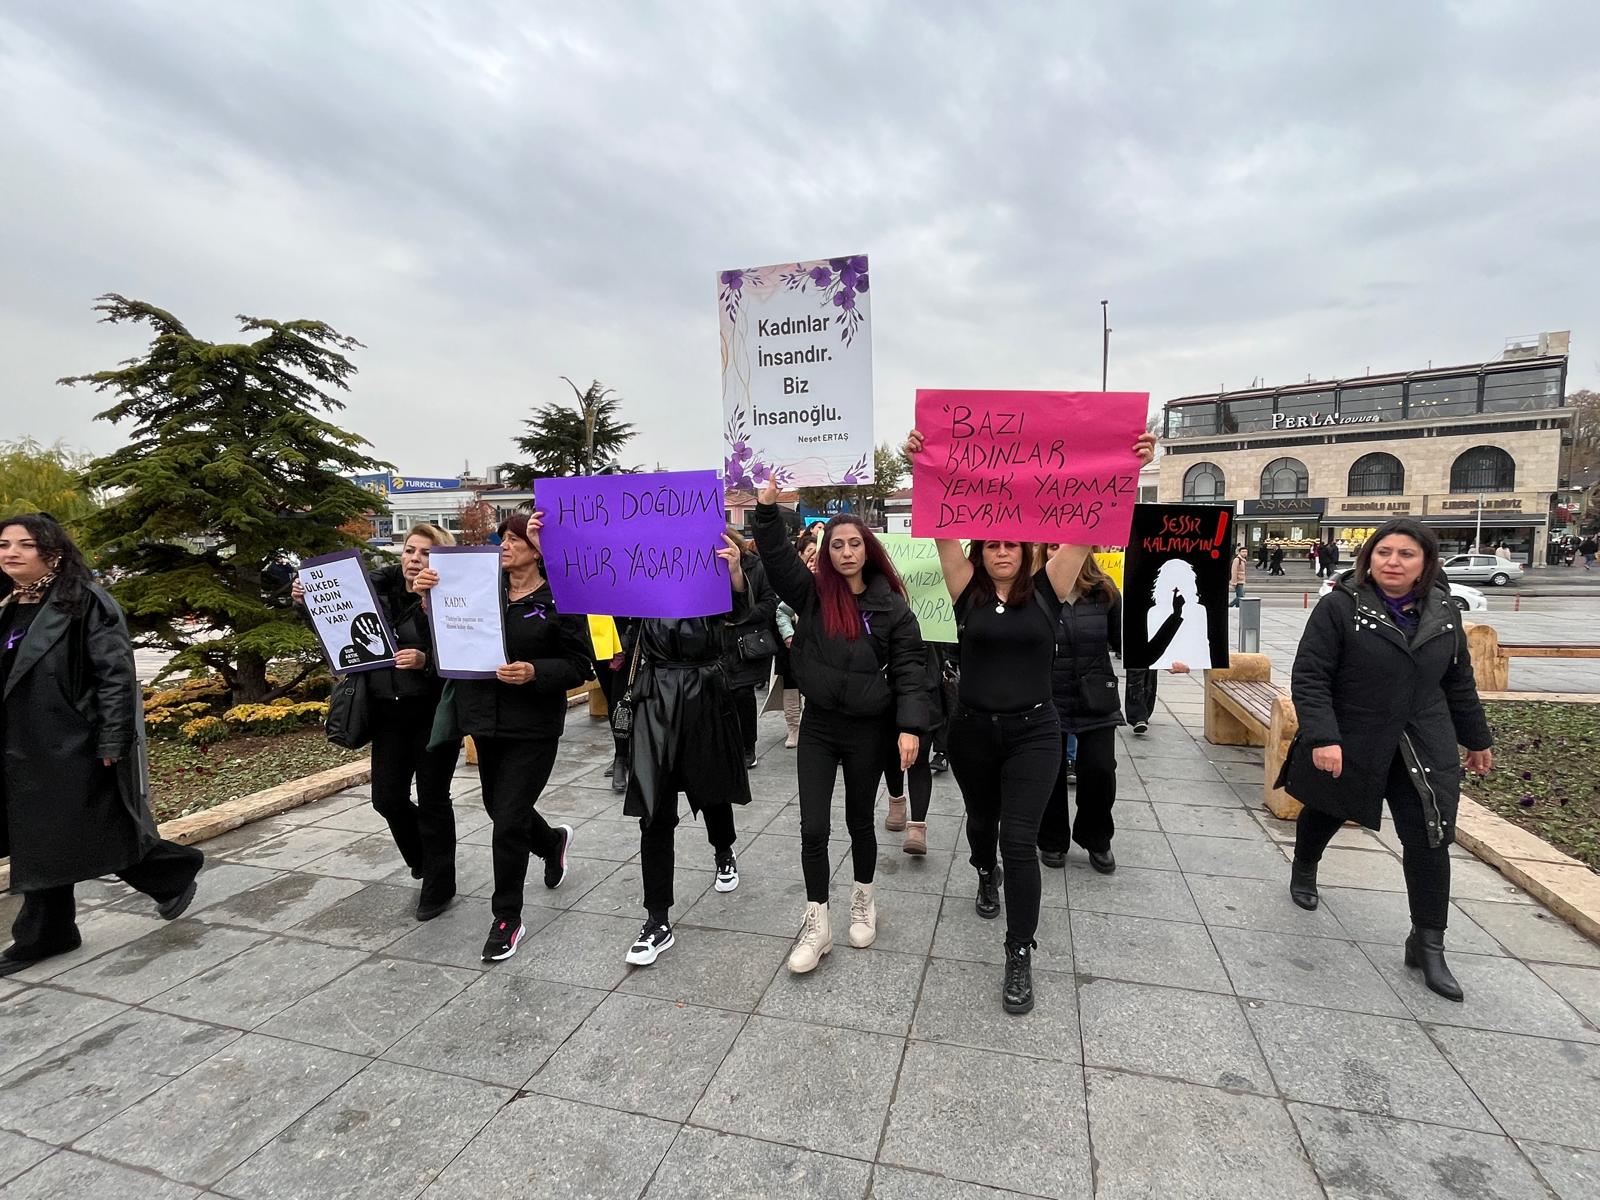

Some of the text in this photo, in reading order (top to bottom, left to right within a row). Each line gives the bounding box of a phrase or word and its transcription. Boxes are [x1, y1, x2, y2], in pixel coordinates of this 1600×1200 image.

[758, 315, 830, 337] Kadınlar
[758, 345, 832, 367] İnsandır.
[783, 377, 809, 395] Biz
[753, 405, 841, 428] İnsanoğlu.
[1271, 411, 1336, 430] PERLA
[798, 433, 849, 444] Neşet ERTAŞ
[946, 440, 1065, 475] KADINLAR
[405, 480, 443, 489] TURKCELL
[938, 472, 1135, 500] YEMEK YAPMAZ
[558, 485, 722, 527] HÜR DOĞDUM
[936, 502, 1022, 528] DEVRİM
[310, 569, 324, 580] BU
[563, 543, 721, 586] HÜR YAŞARIM
[305, 578, 340, 593] ÜLKEDE
[312, 590, 342, 604] KADIN
[325, 613, 349, 625] VAR!
